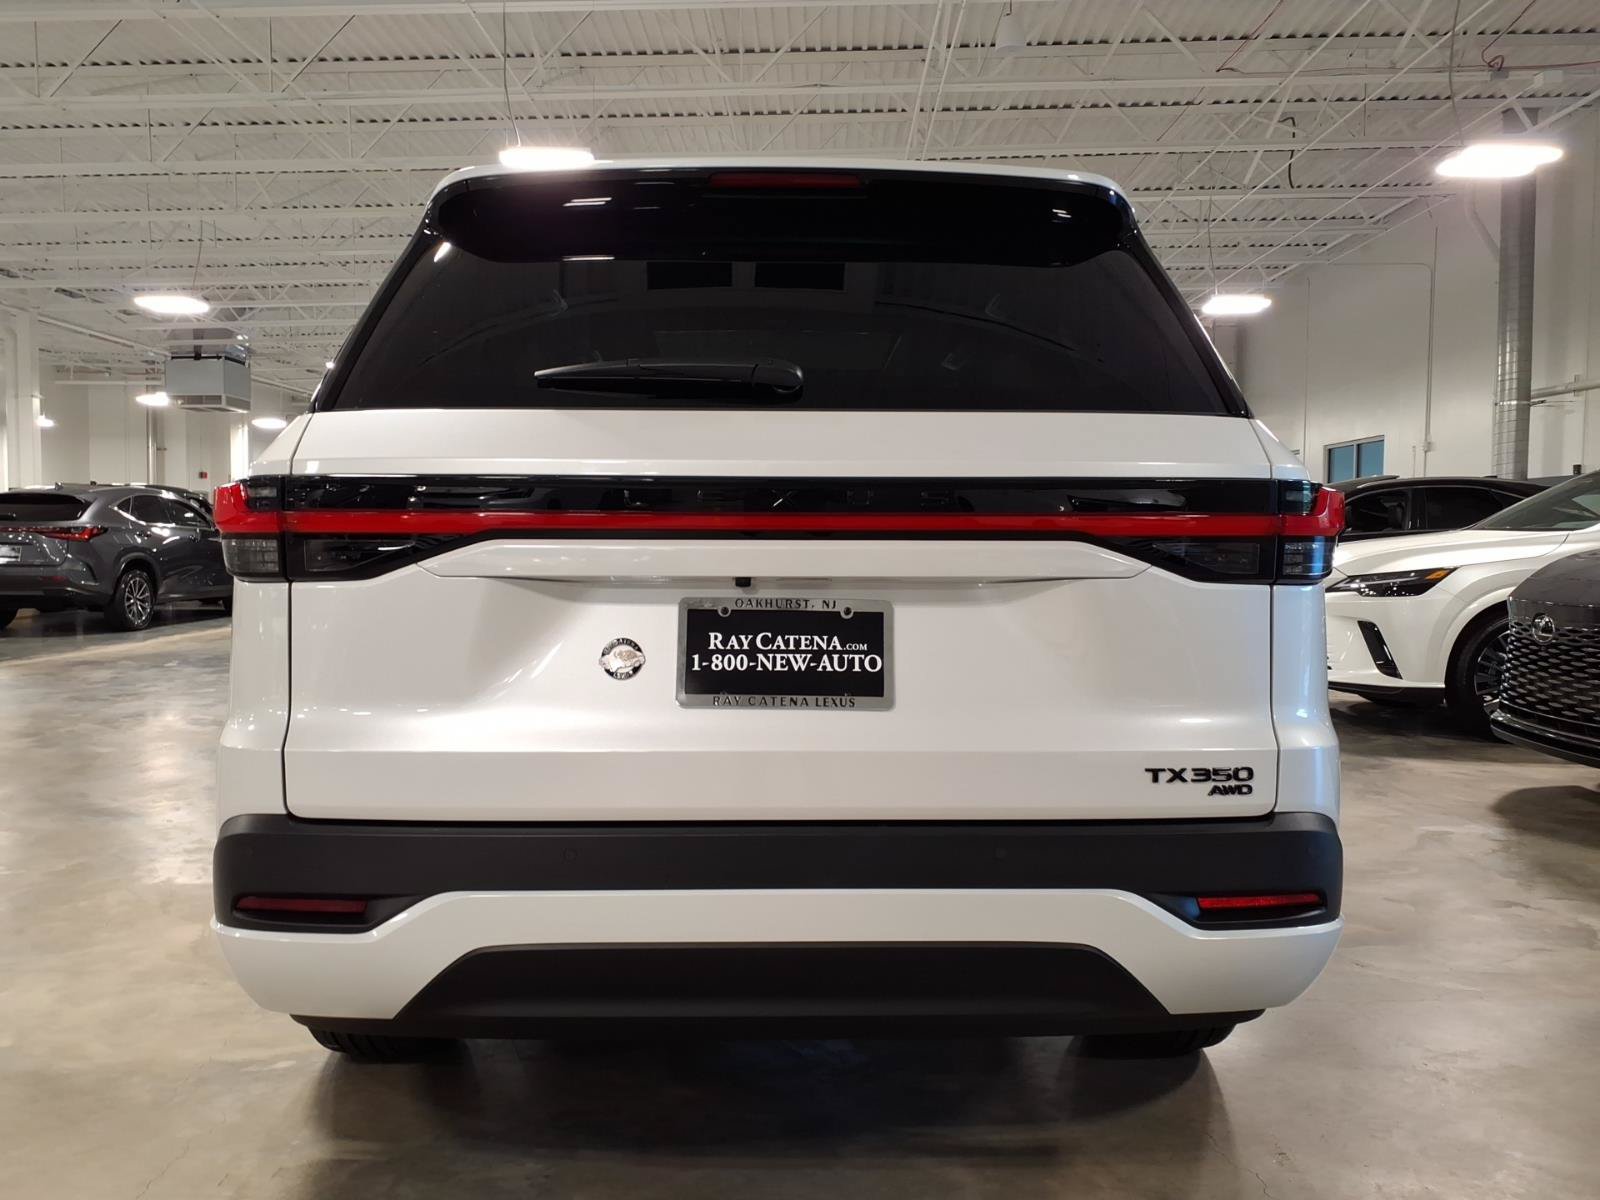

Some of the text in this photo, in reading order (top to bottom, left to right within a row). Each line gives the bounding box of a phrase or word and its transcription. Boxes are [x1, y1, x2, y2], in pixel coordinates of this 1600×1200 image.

[822, 600, 836, 609] NJ
[708, 632, 753, 650] RAY
[691, 653, 882, 672] 1-800-NEW-AUTO
[712, 695, 855, 708] RAY CATENA LEXUS
[1207, 784, 1253, 796] AWD
